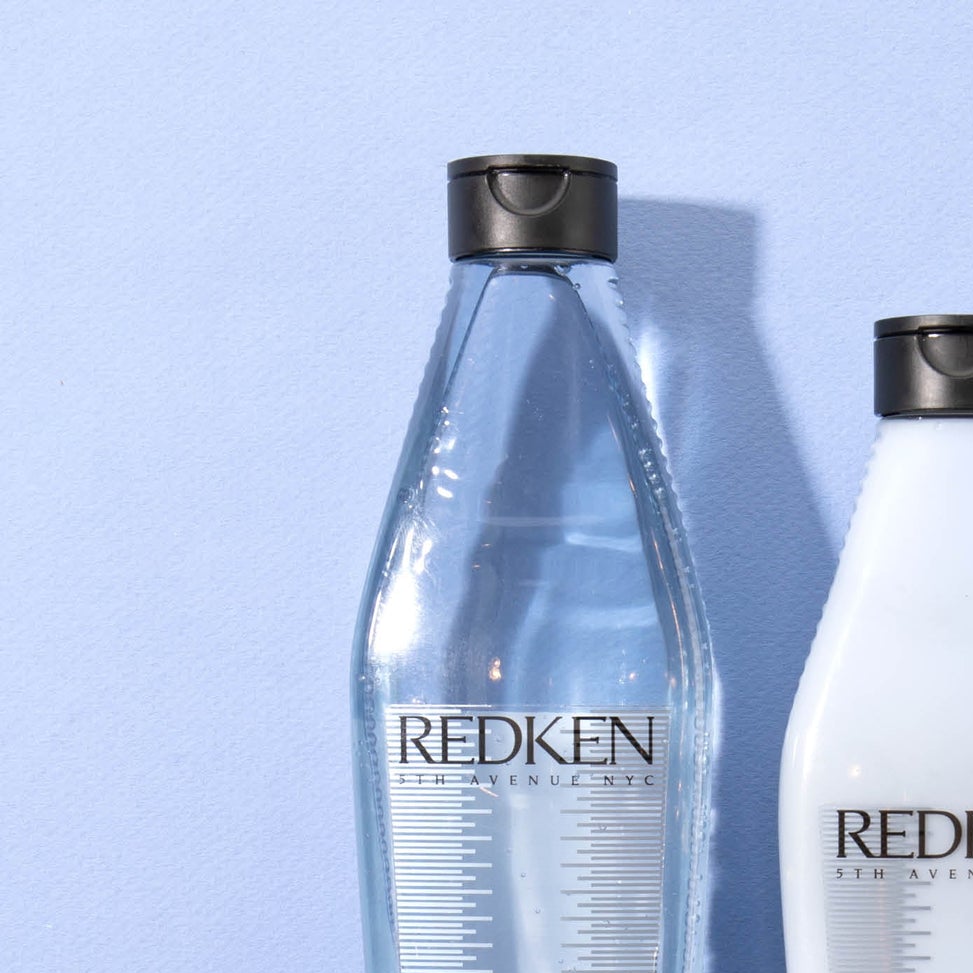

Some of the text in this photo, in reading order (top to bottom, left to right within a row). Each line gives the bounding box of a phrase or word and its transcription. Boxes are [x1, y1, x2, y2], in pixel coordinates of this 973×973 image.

[399, 716, 655, 765] REDKEN
[399, 774, 655, 786] 5TH AVENUE NYC
[836, 868, 884, 880] 5TH
